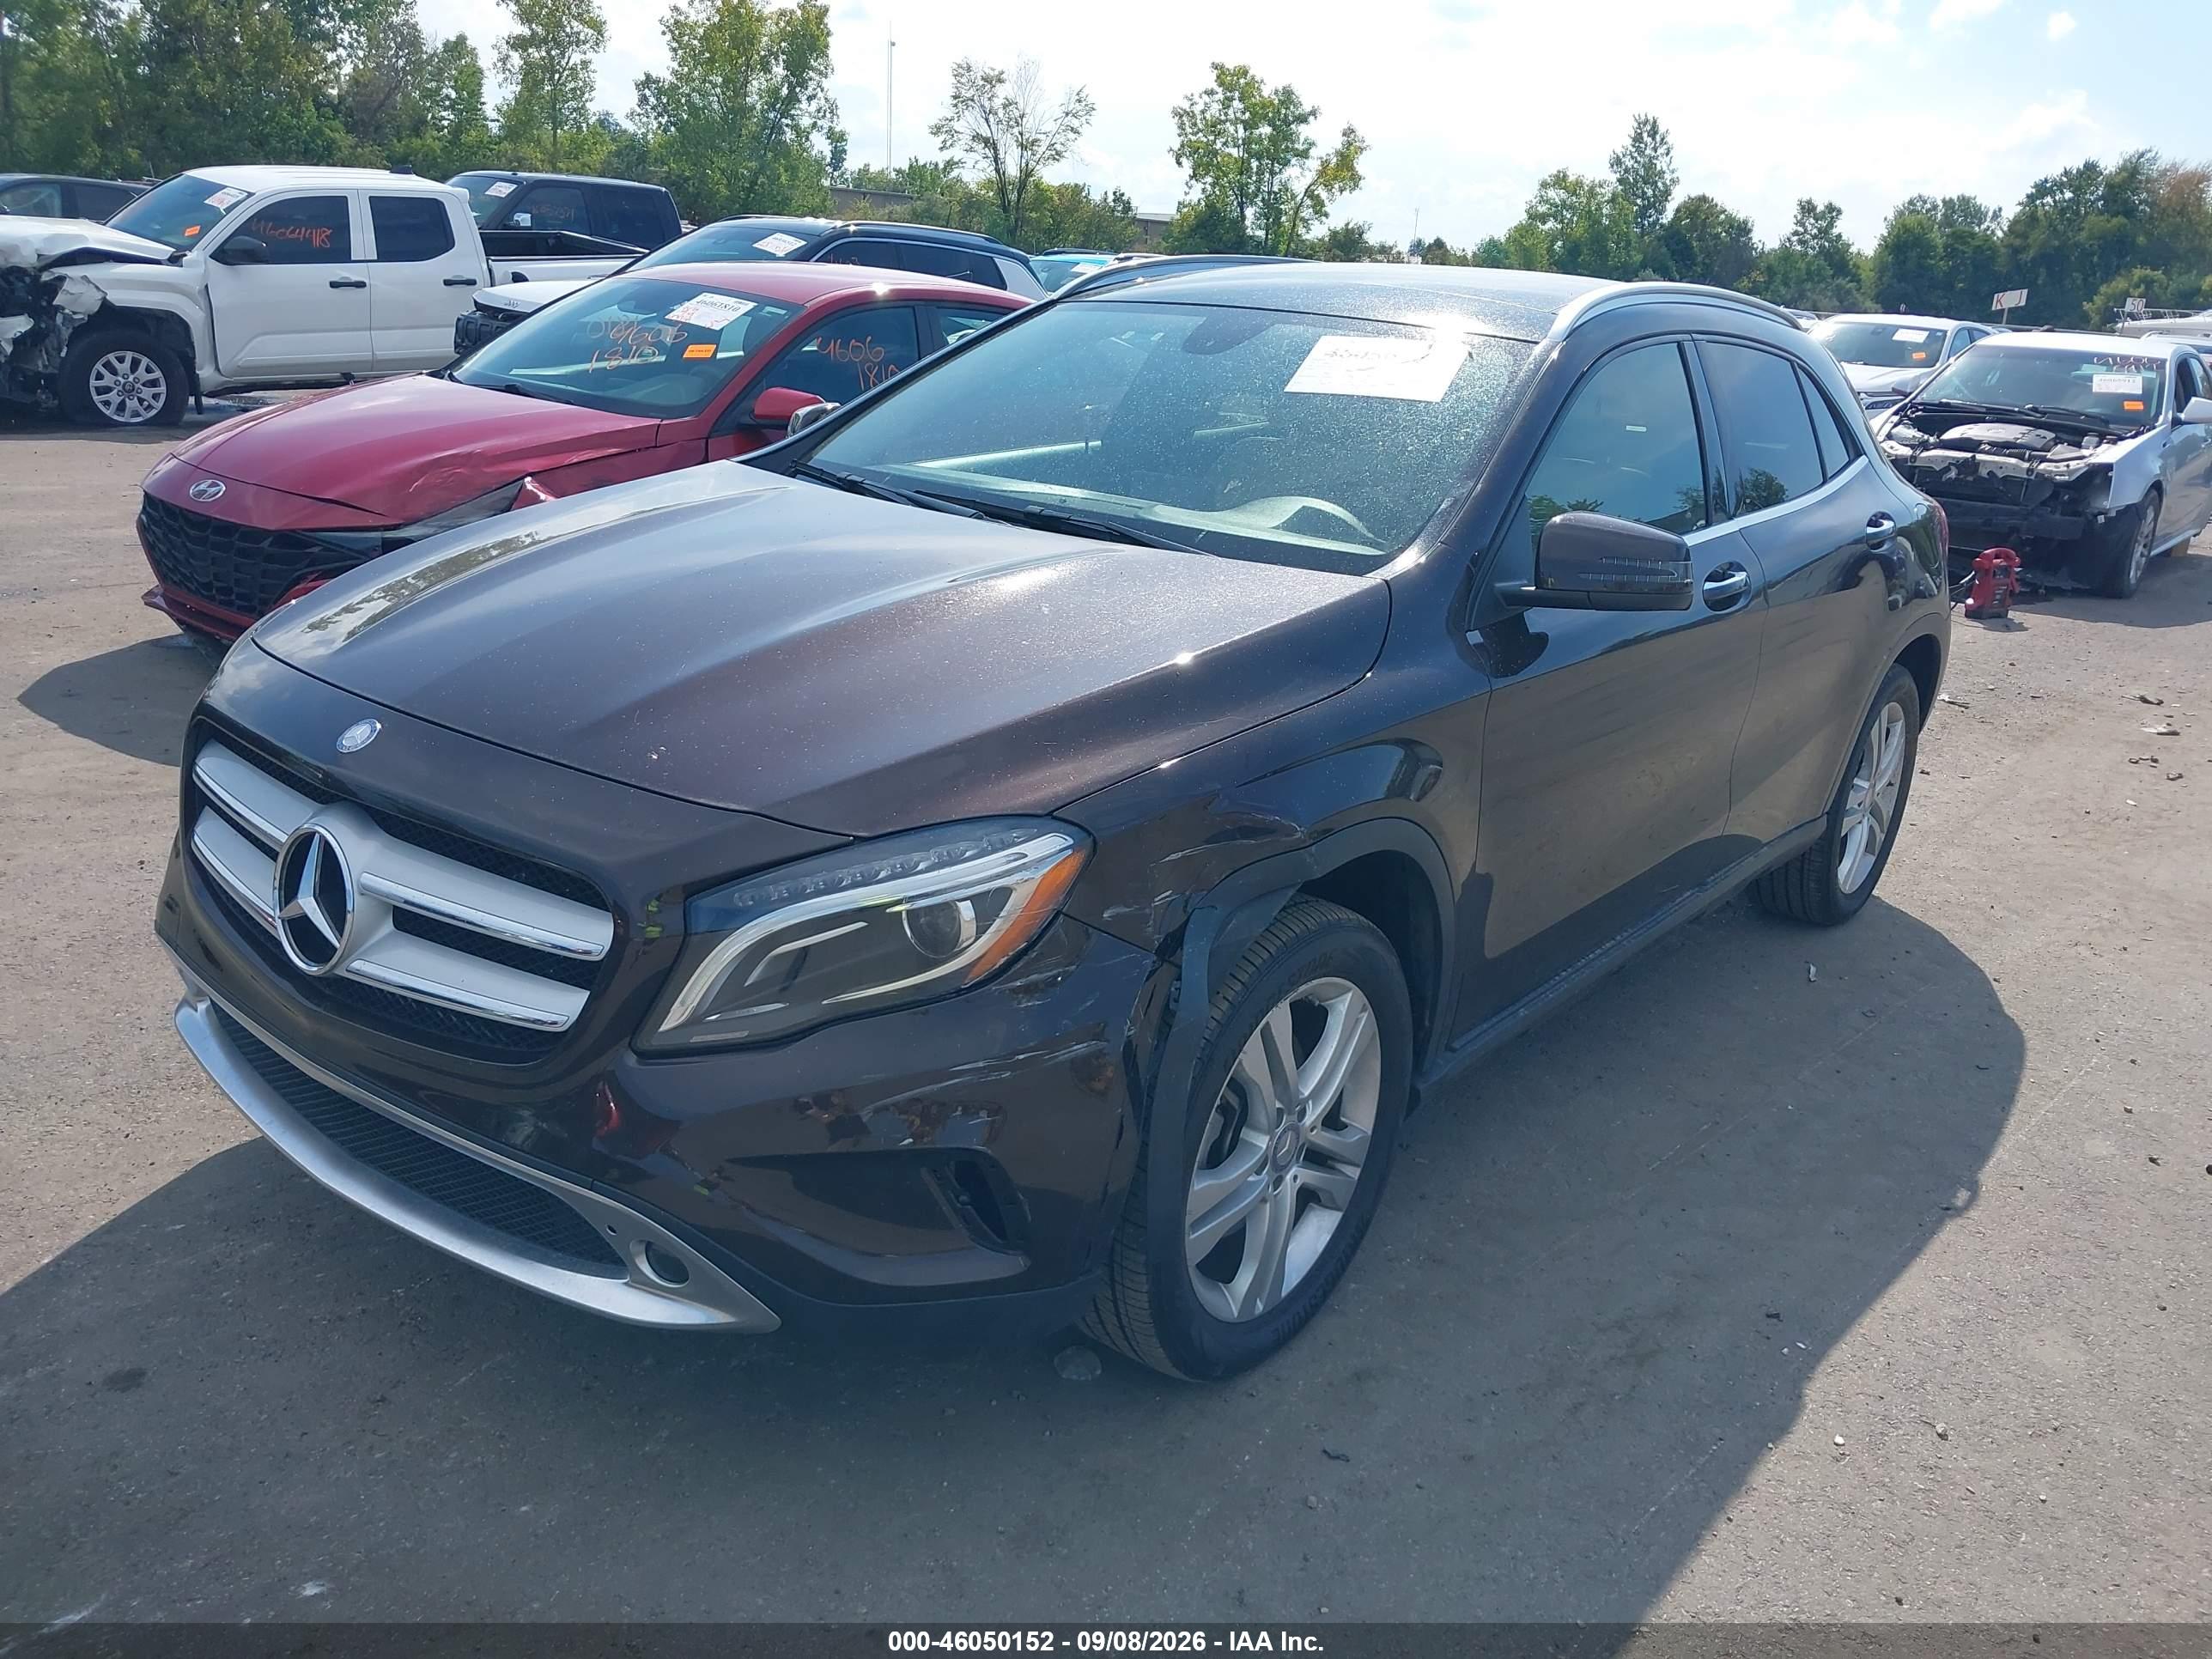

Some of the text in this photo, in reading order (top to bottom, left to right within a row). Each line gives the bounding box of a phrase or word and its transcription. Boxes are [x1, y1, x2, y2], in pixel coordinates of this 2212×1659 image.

[1995, 290, 2024, 308] K J
[2129, 298, 2144, 313] 50
[817, 336, 885, 362] 4606
